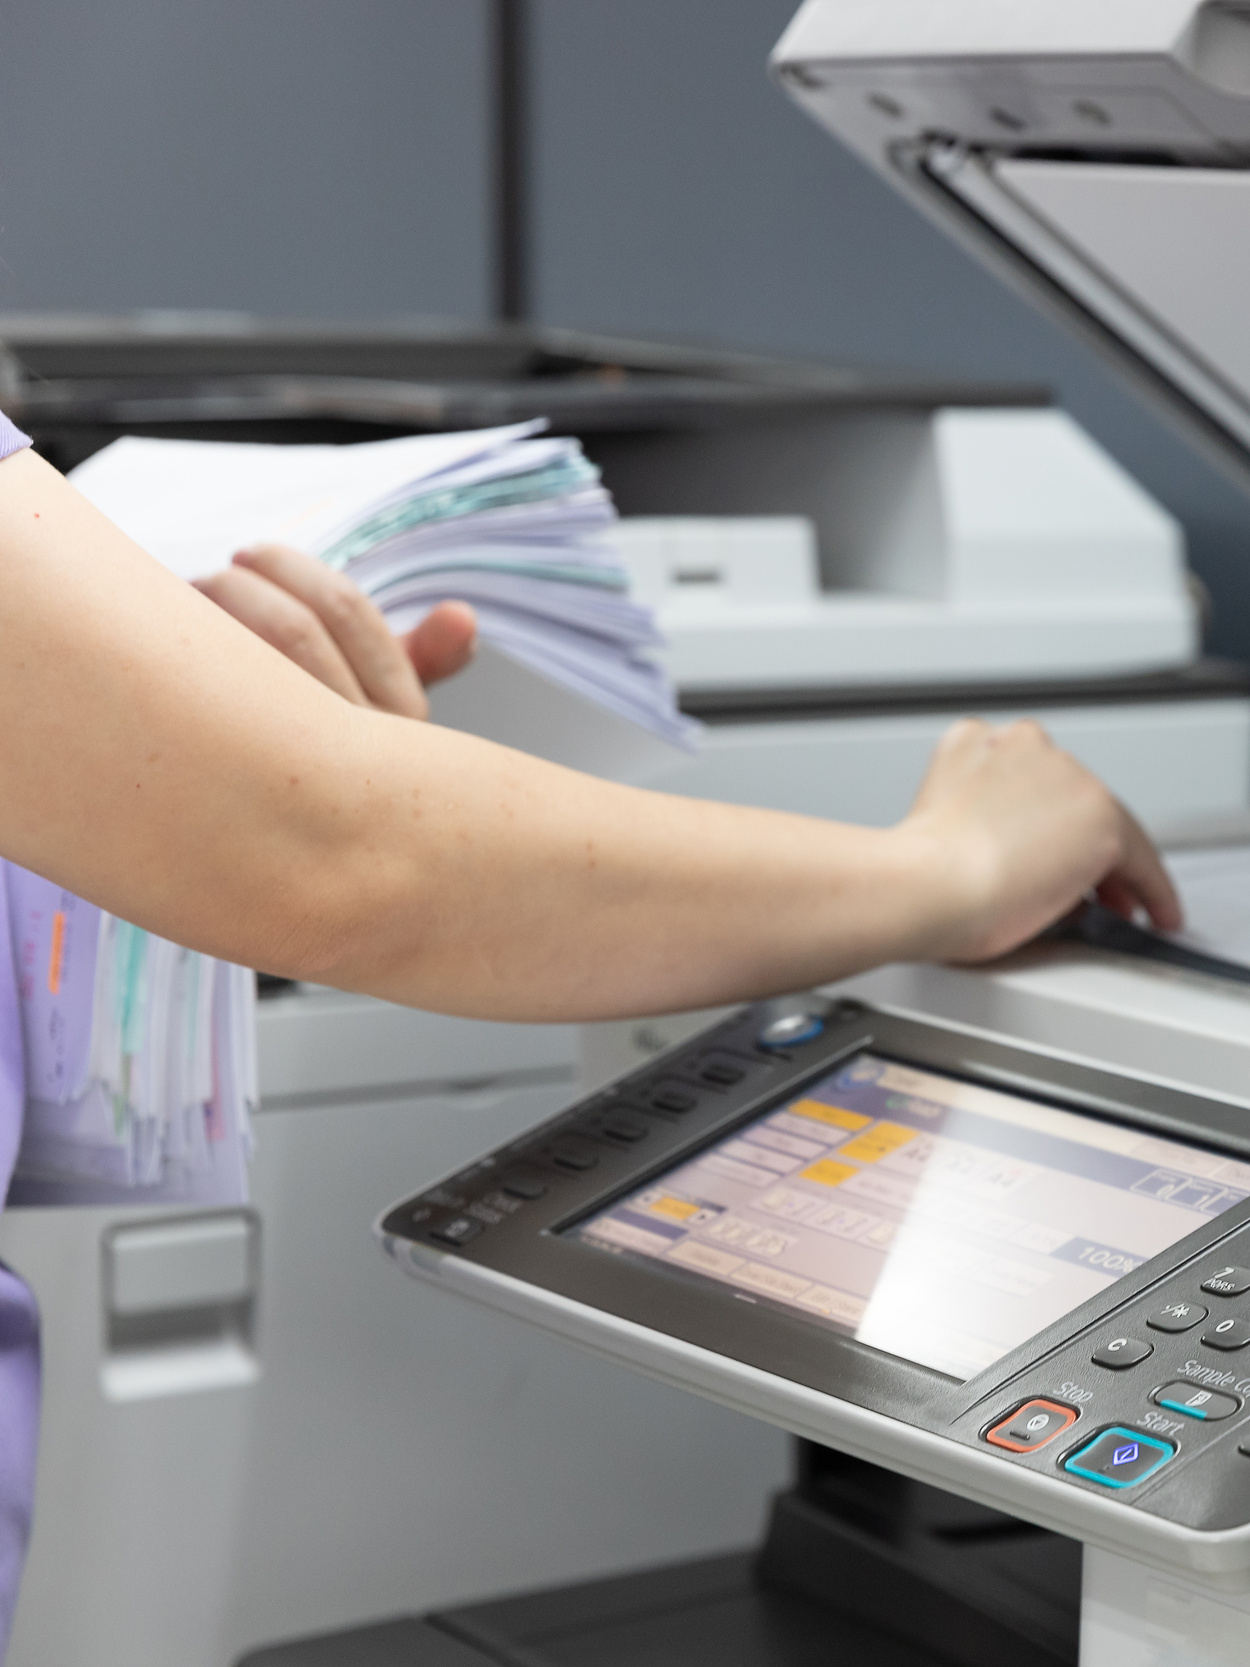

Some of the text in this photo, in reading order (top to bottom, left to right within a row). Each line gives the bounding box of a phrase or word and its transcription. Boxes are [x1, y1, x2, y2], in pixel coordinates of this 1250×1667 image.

[1213, 1266, 1236, 1279] 7
[1215, 1319, 1236, 1333] 0
[1107, 1338, 1127, 1351] C
[1177, 1359, 1236, 1389] Sample
[1052, 1381, 1094, 1403] Stop
[1136, 1411, 1185, 1438] Start
